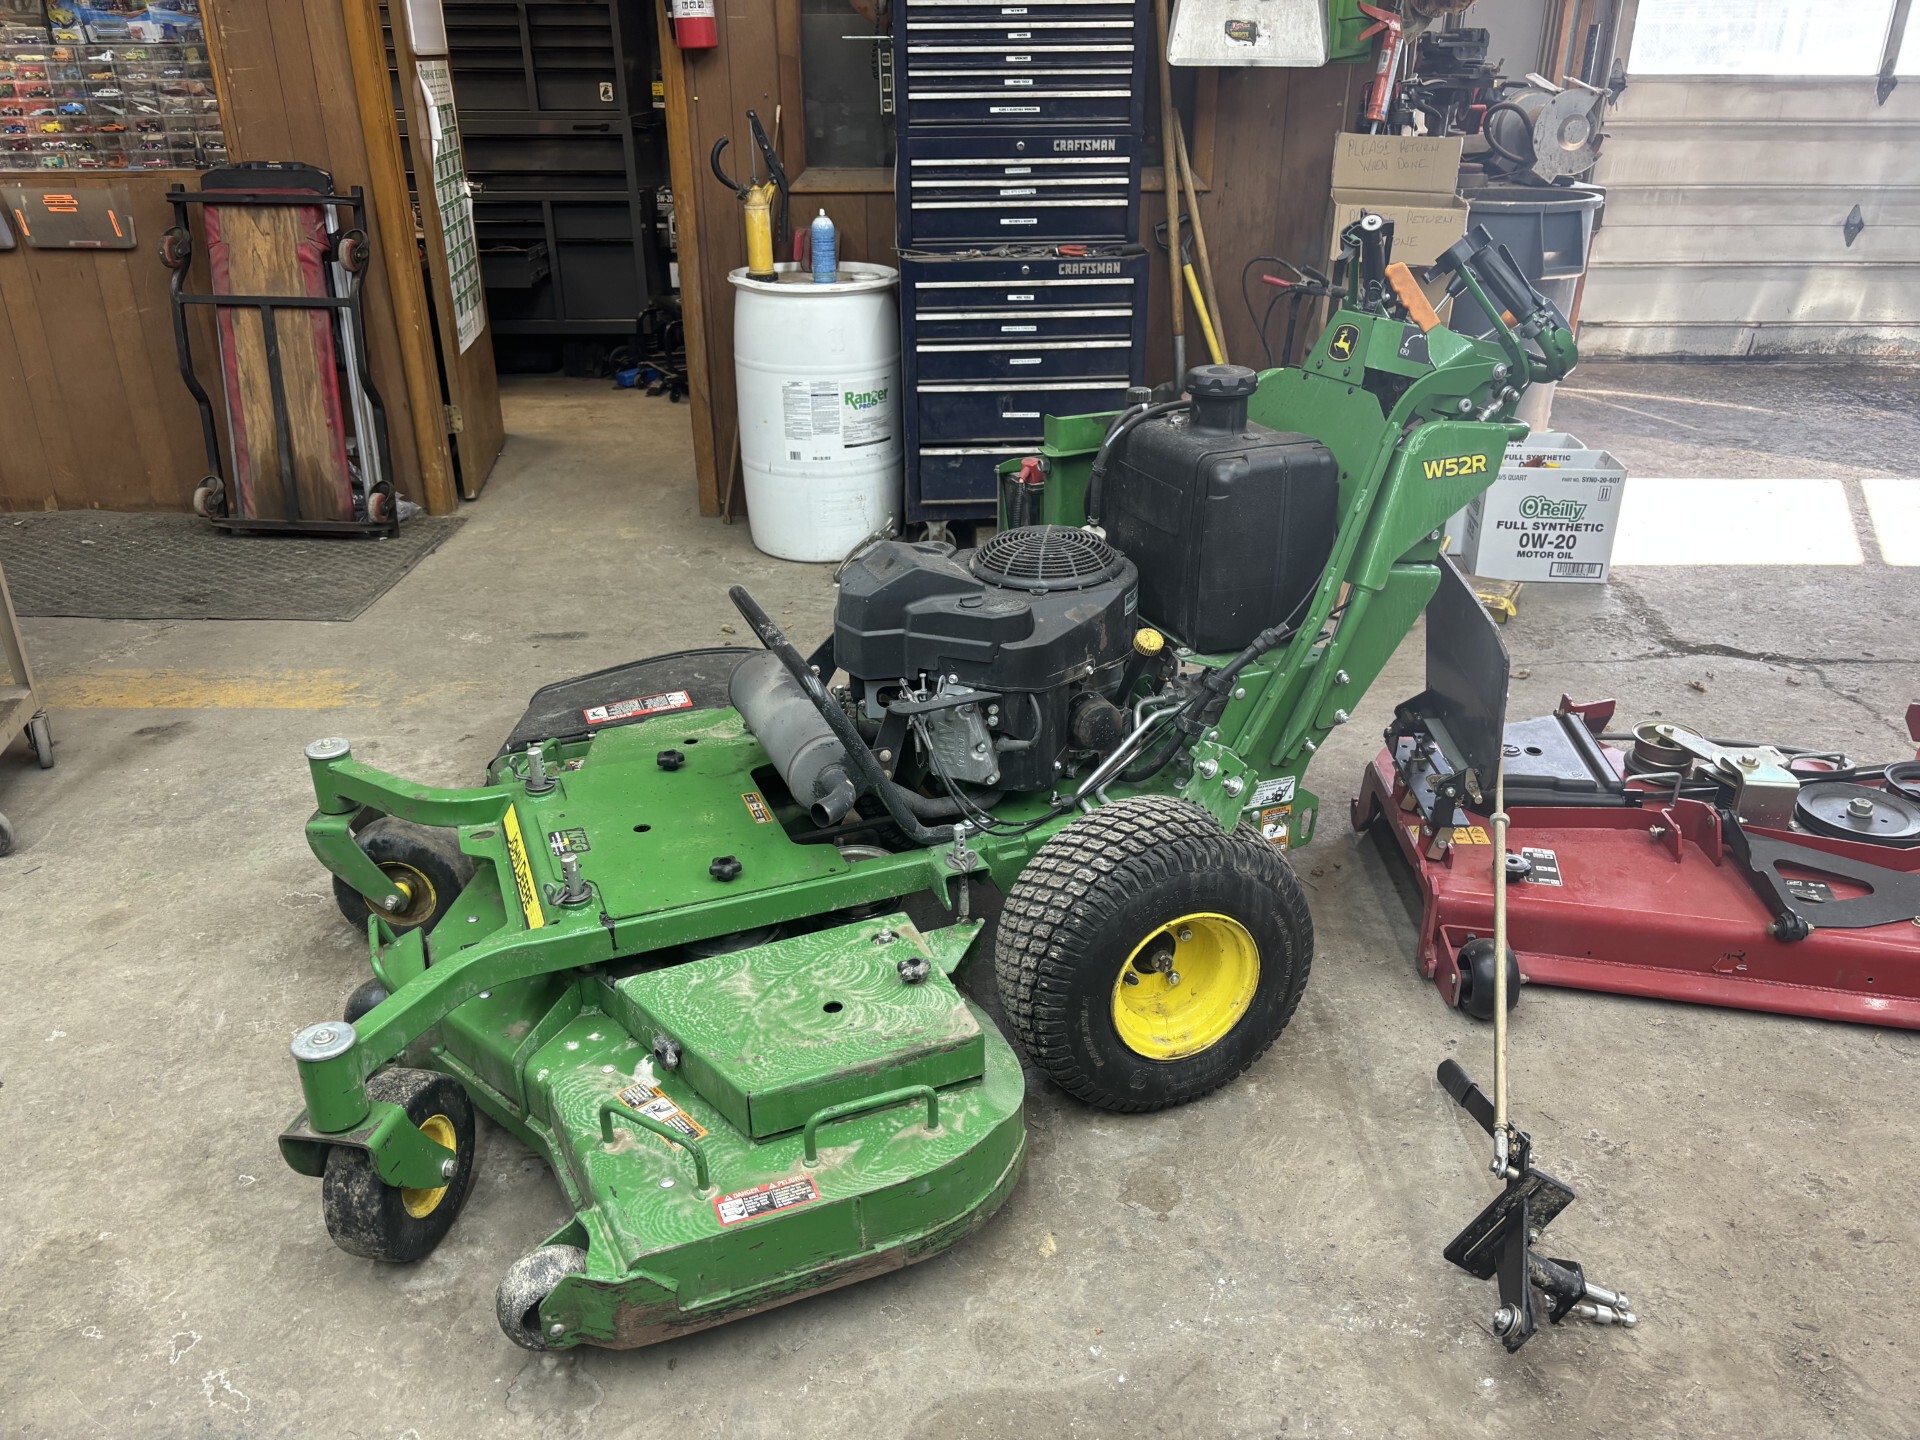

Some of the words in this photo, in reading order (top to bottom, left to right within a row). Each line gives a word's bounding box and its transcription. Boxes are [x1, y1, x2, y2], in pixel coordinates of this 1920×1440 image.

[1053, 138, 1116, 152] CRAFTSMAN
[1348, 139, 1391, 157] PLEASE
[1359, 159, 1389, 172] WHEN
[1397, 157, 1429, 171] DONE
[1406, 210, 1454, 225] RETURN
[1392, 236, 1418, 247] ONE
[1058, 262, 1121, 276] CRAFTSMAN
[844, 388, 889, 410] Ranger
[1423, 453, 1488, 480] W52R
[1507, 474, 1528, 482] QUART
[1520, 496, 1586, 521] O'Reilly
[1496, 520, 1528, 531] FULL
[1532, 521, 1604, 532] SYNTHETIC
[1519, 532, 1577, 550] 0W-20
[1516, 550, 1554, 559] MOTOR
[1557, 551, 1574, 560] OIL
[508, 832, 523, 870] JOHN
[516, 861, 534, 911] DEERE
[732, 1187, 760, 1199] DANGER
[776, 1174, 805, 1187] PELIGRO
